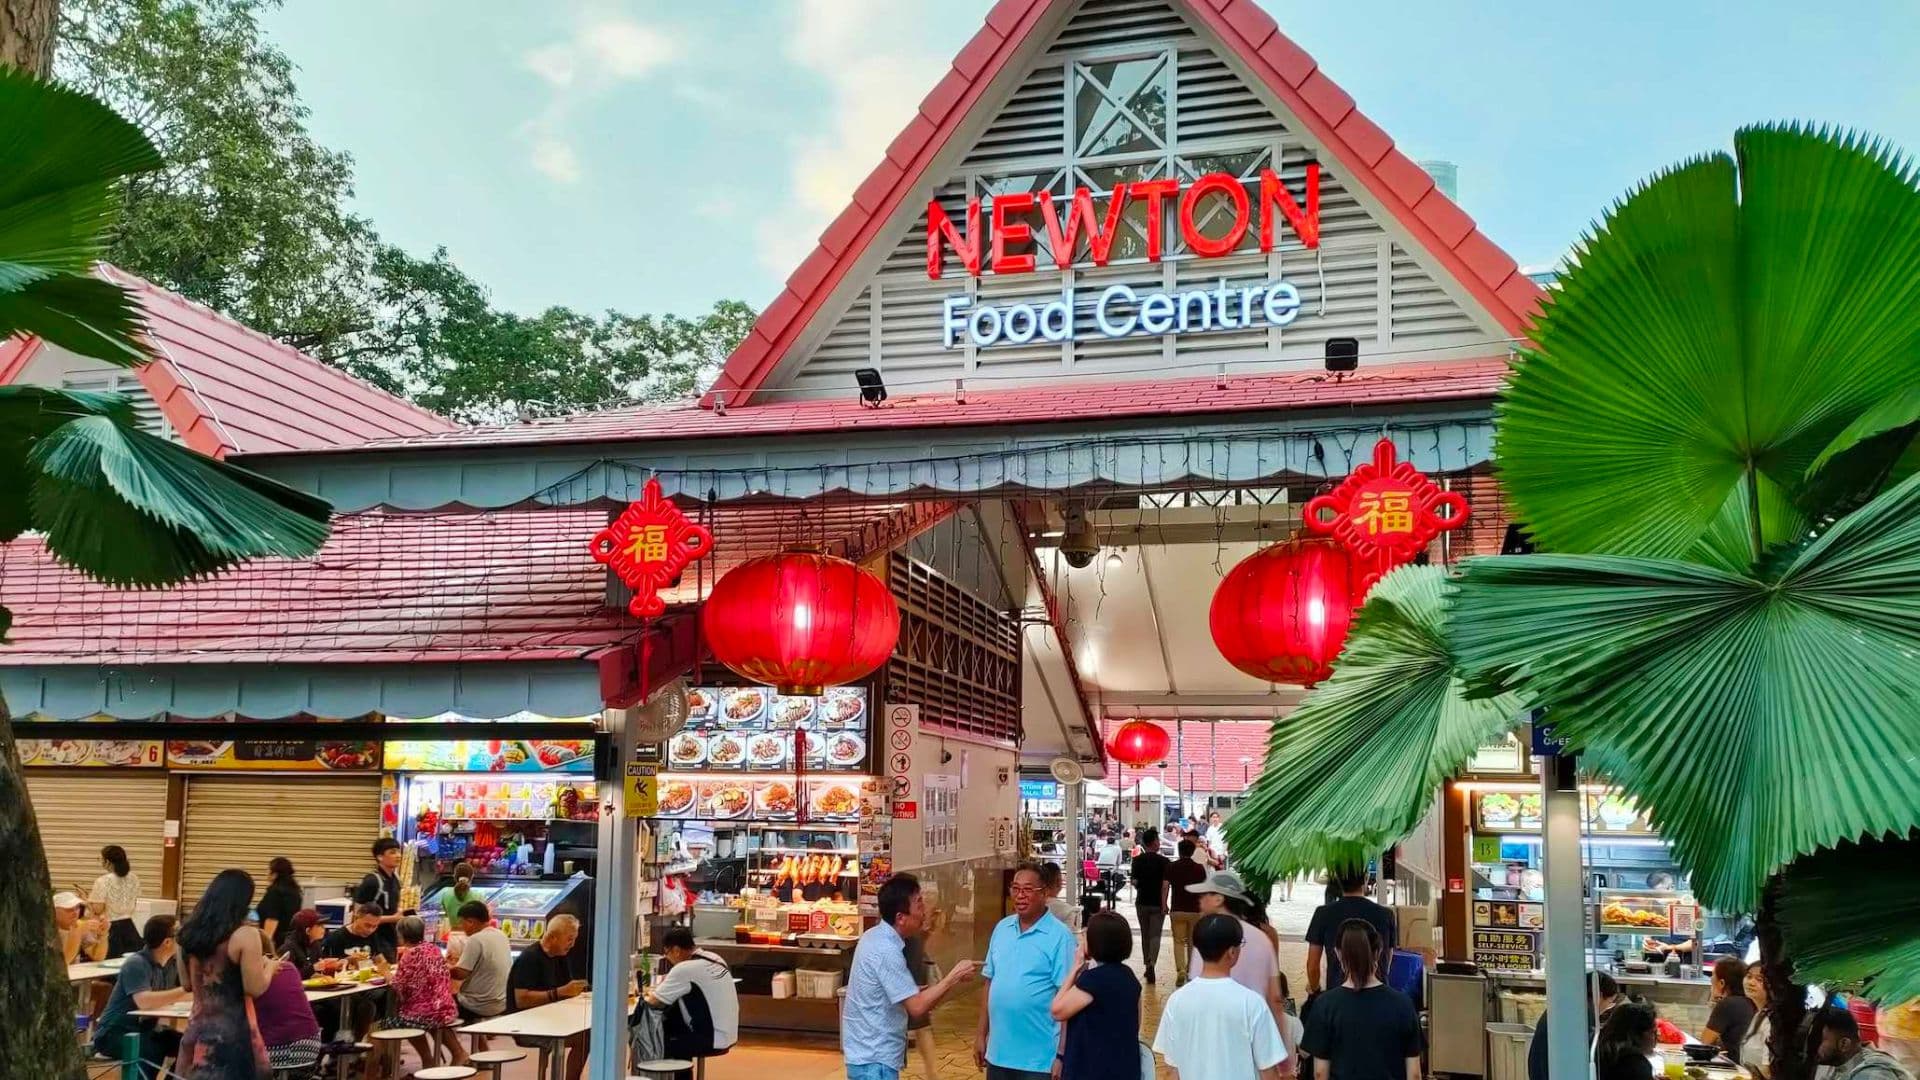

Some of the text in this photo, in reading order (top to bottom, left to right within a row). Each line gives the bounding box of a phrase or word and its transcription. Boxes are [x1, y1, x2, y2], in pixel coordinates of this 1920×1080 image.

[926, 164, 1320, 279] NEWTON
[943, 279, 1301, 350] Food Centre
[1352, 491, 1414, 535] 福
[623, 525, 669, 564] 福
[148, 745, 158, 763] 6
[628, 766, 656, 776] CAUTION
